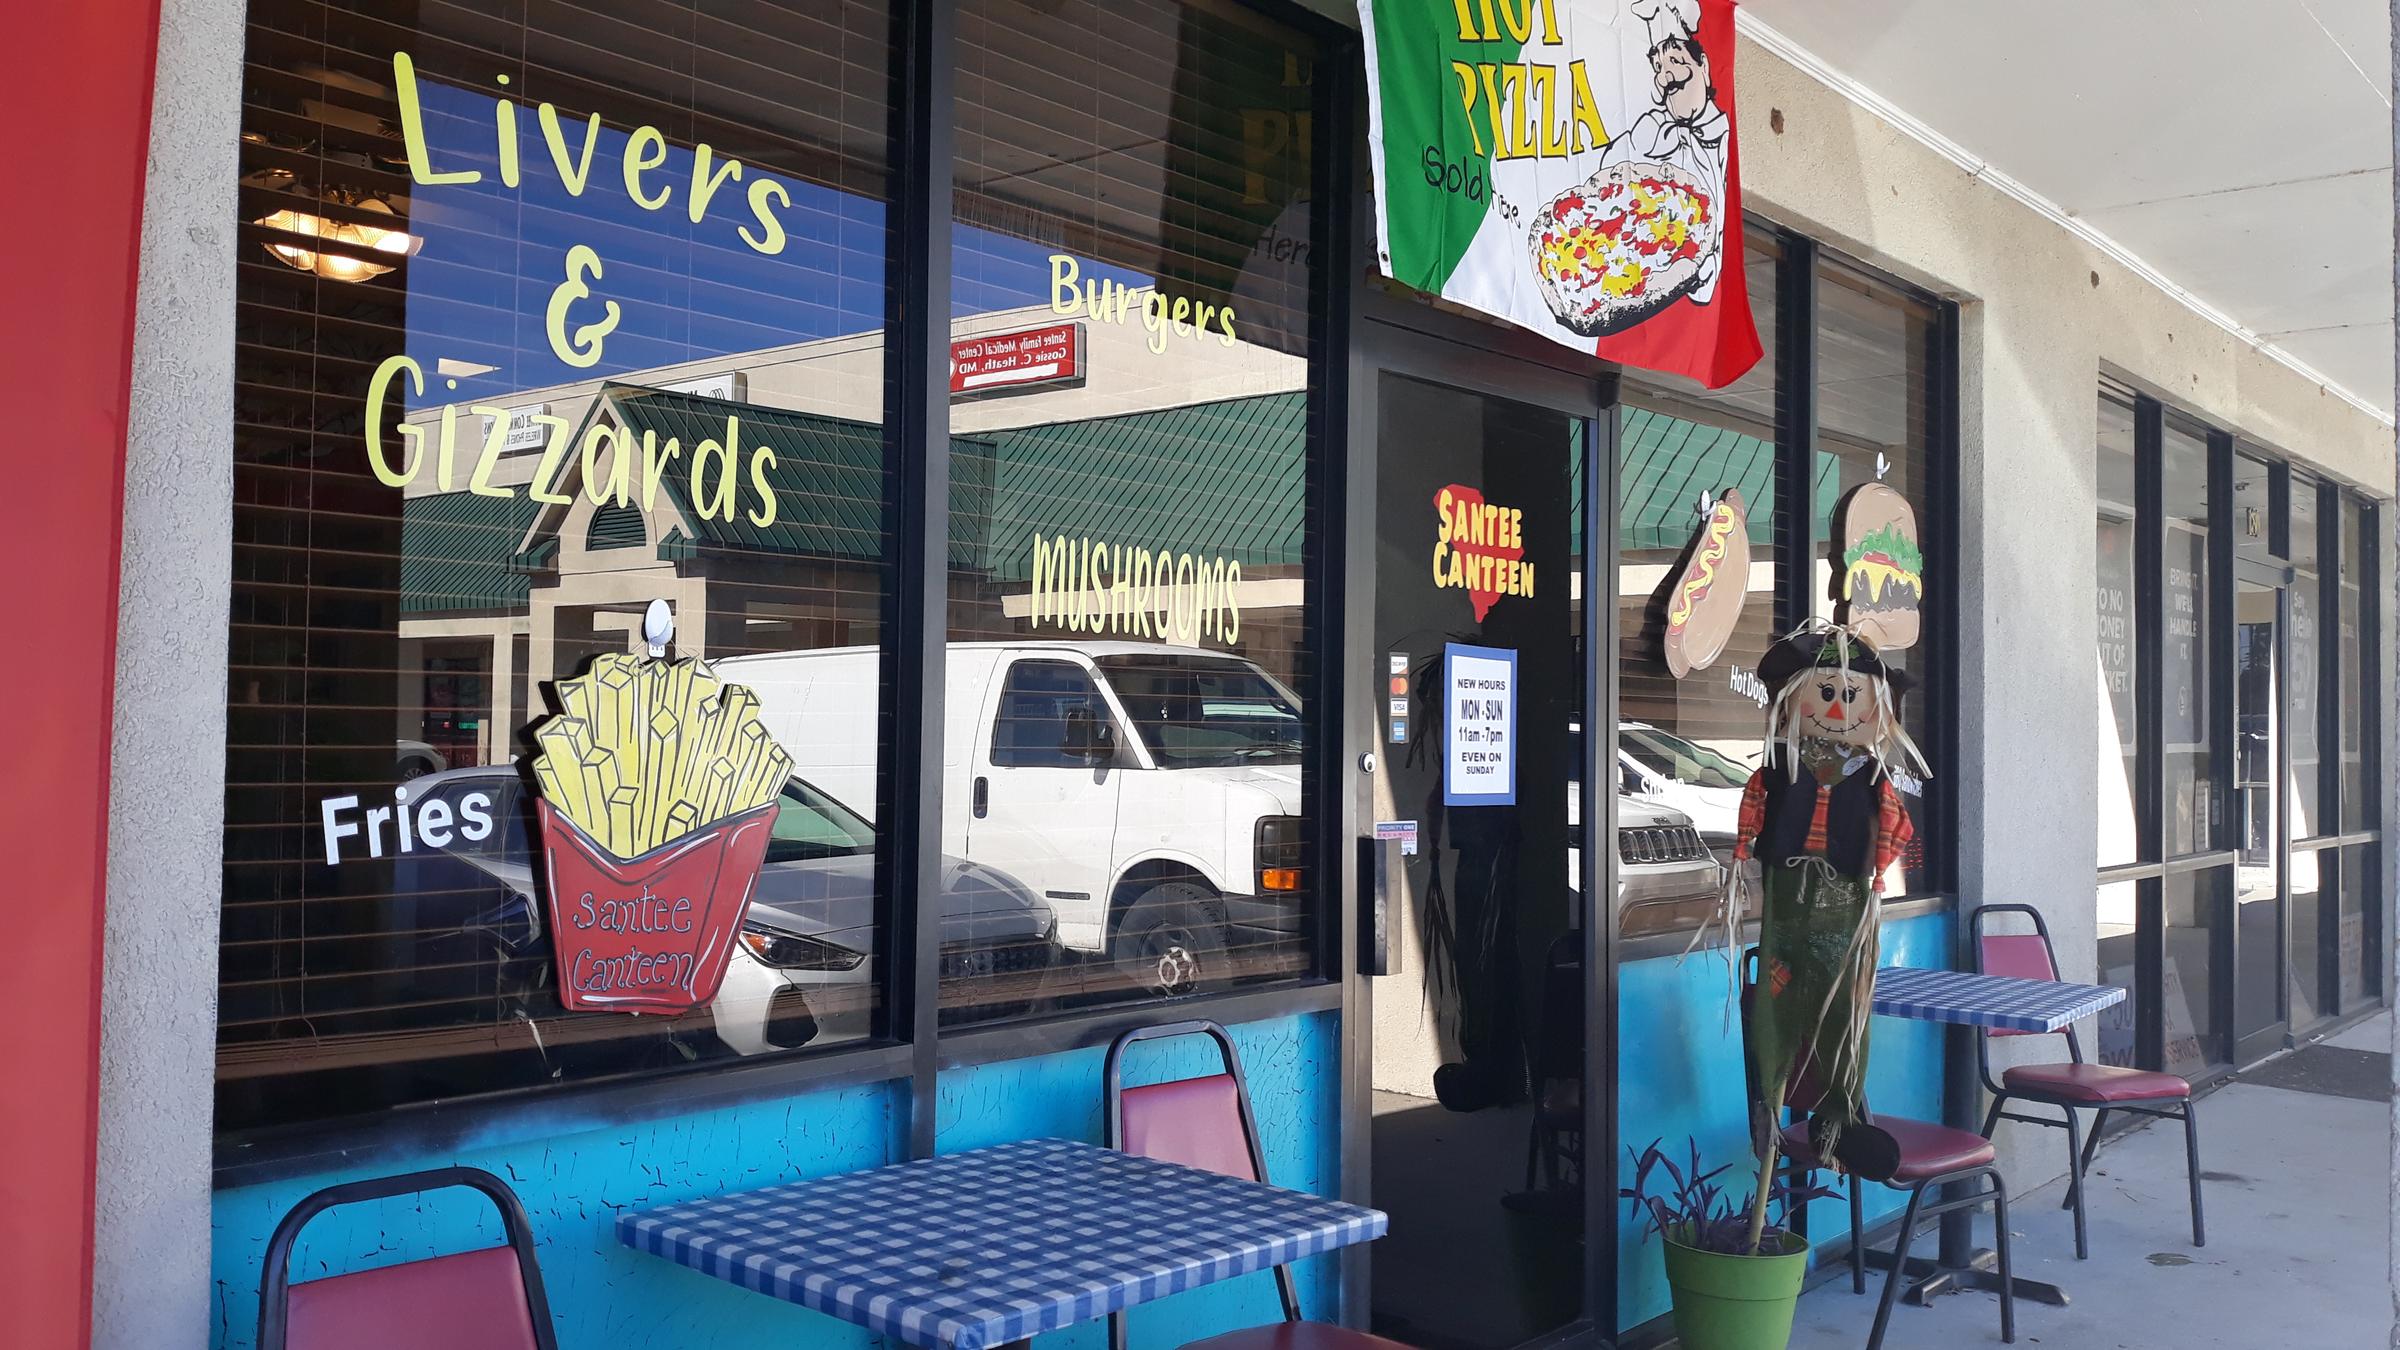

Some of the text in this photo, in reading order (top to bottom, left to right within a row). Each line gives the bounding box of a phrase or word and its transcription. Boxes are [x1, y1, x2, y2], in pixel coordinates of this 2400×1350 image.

[1450, 56, 1611, 163] PIZZA
[393, 51, 791, 256] Livers
[1422, 145, 1484, 205] Sold
[546, 245, 621, 368] &
[1048, 254, 1237, 355] Burgers
[365, 355, 778, 528] Gizzards
[1438, 489, 1522, 549] SANTEE
[1031, 532, 1241, 645] MUSHROOMS
[1433, 541, 1535, 599] CANTEEN
[2097, 615, 2126, 639] ONEY
[2109, 588, 2124, 612] NO
[1457, 678, 1506, 690] NEW HOURS
[1461, 699, 1480, 720] MON
[1486, 699, 1503, 721] SUN
[1459, 726, 1480, 742] 11am
[1461, 752, 1502, 762] EVEN ON
[1466, 766, 1495, 775] SUNDAY
[320, 786, 493, 866] Fries
[573, 884, 691, 935] Santee
[573, 945, 694, 992] Canteen
